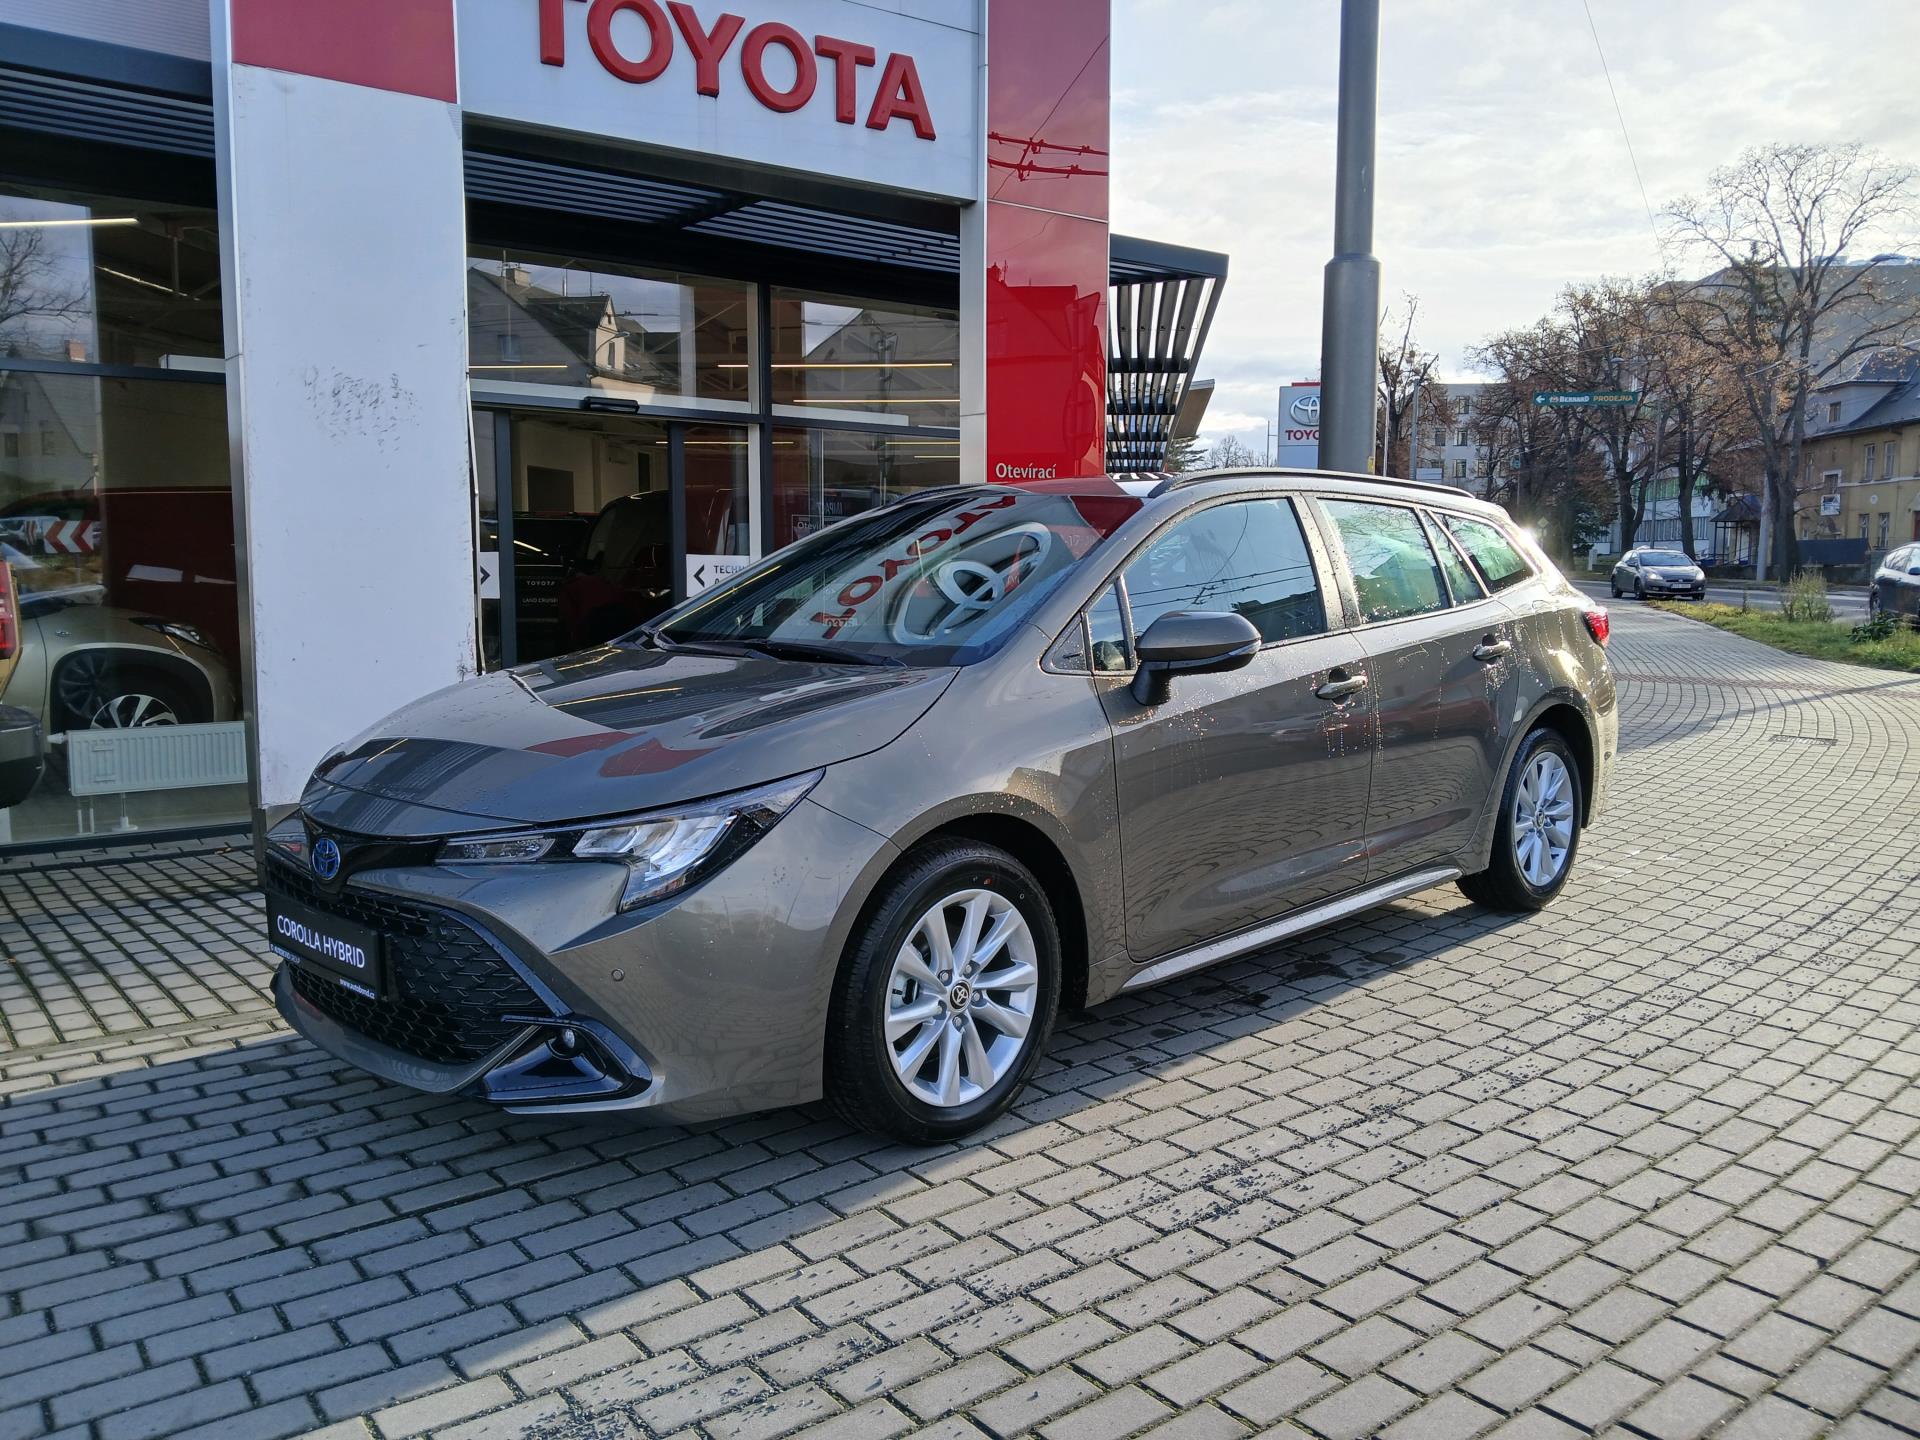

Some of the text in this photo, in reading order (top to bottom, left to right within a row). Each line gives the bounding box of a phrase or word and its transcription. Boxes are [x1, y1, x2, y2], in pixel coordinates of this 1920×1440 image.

[540, 0, 936, 141] TOYOTA
[1593, 395, 1633, 403] PRODEJNA
[995, 462, 1057, 479] Otevírací
[277, 915, 322, 952] COROLLA
[323, 935, 366, 968] HYBRID
